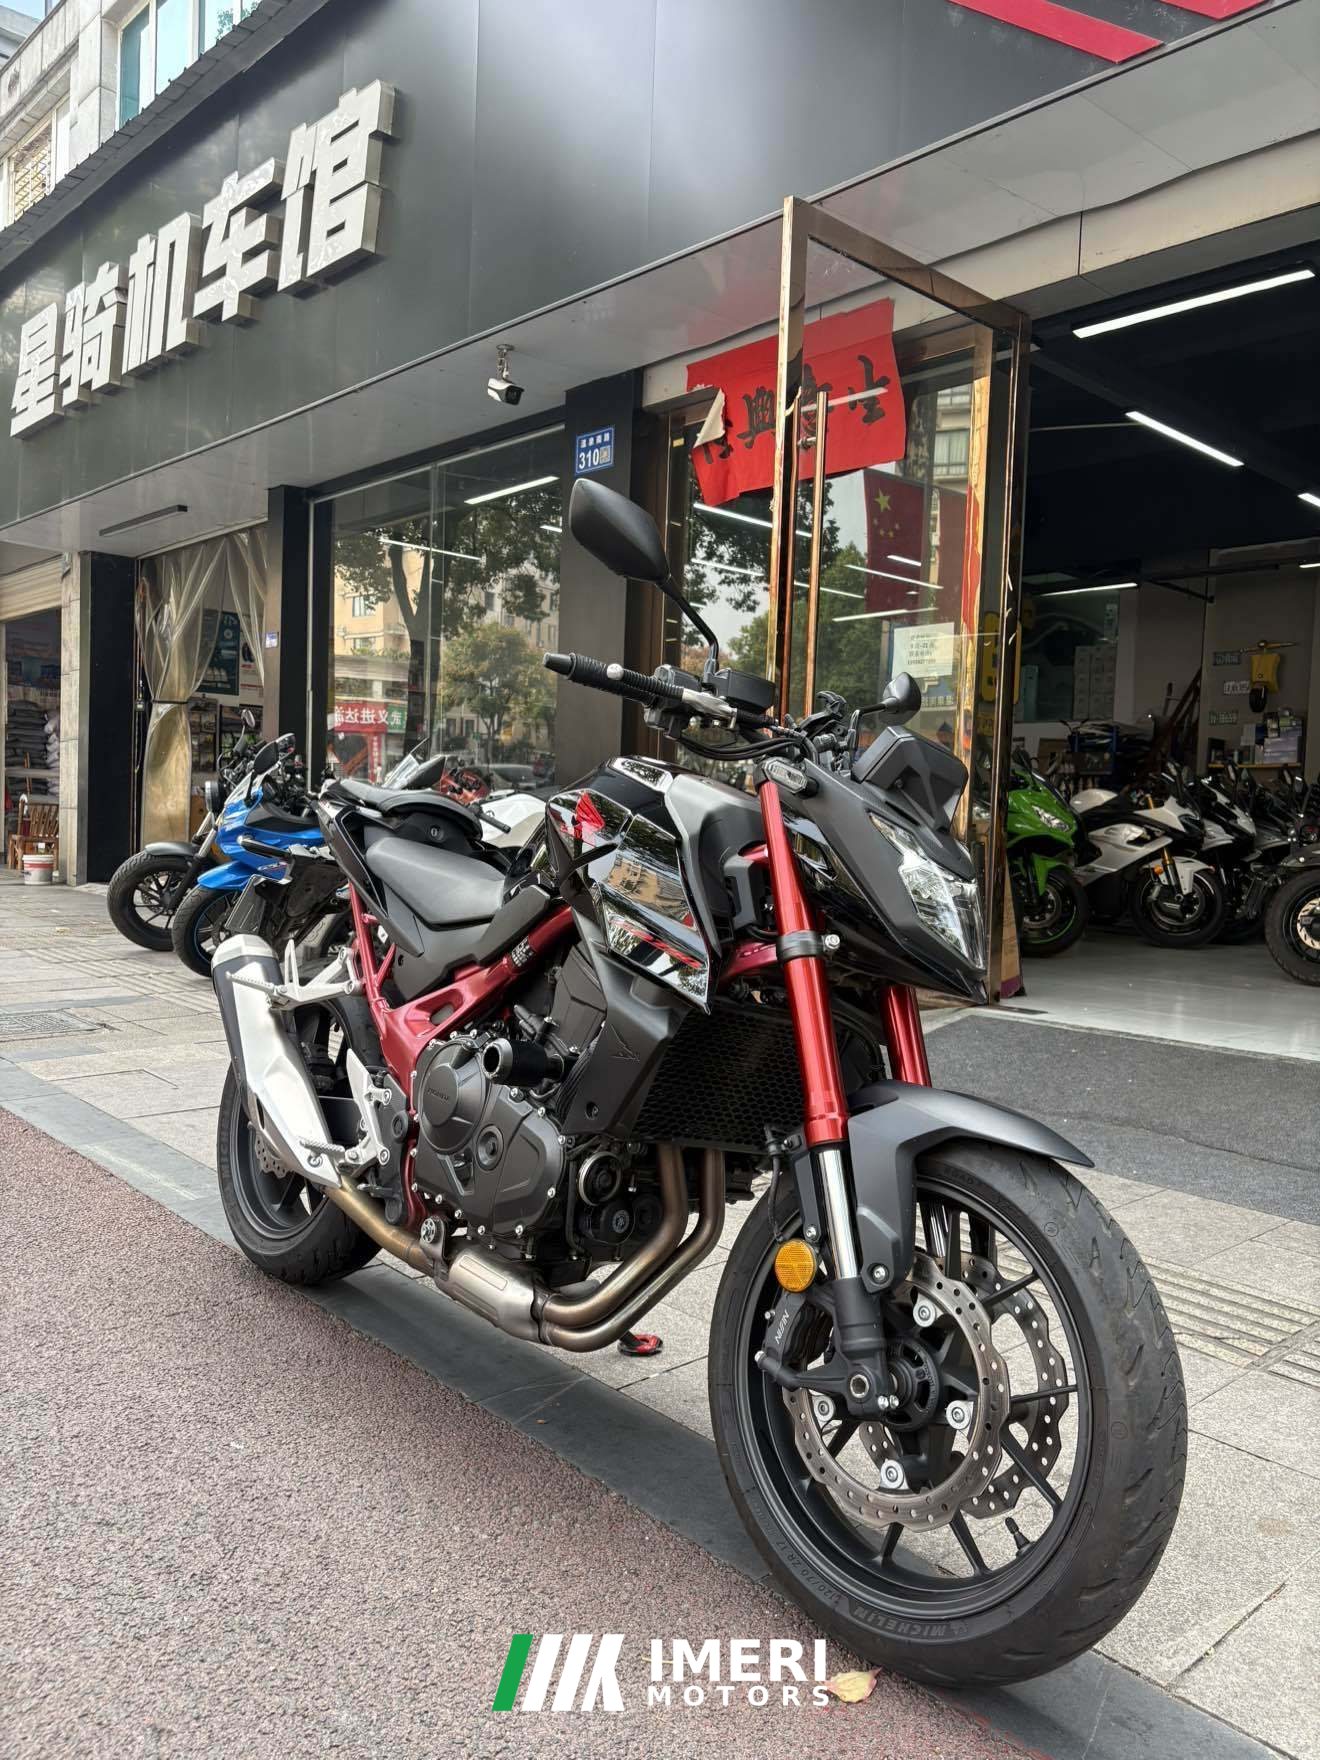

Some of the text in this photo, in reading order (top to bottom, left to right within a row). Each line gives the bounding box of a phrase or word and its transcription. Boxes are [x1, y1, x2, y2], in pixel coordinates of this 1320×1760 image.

[10, 79, 395, 440] 星骑机车馆
[578, 448, 600, 470] 310
[853, 1605, 947, 1636] MICHELIN
